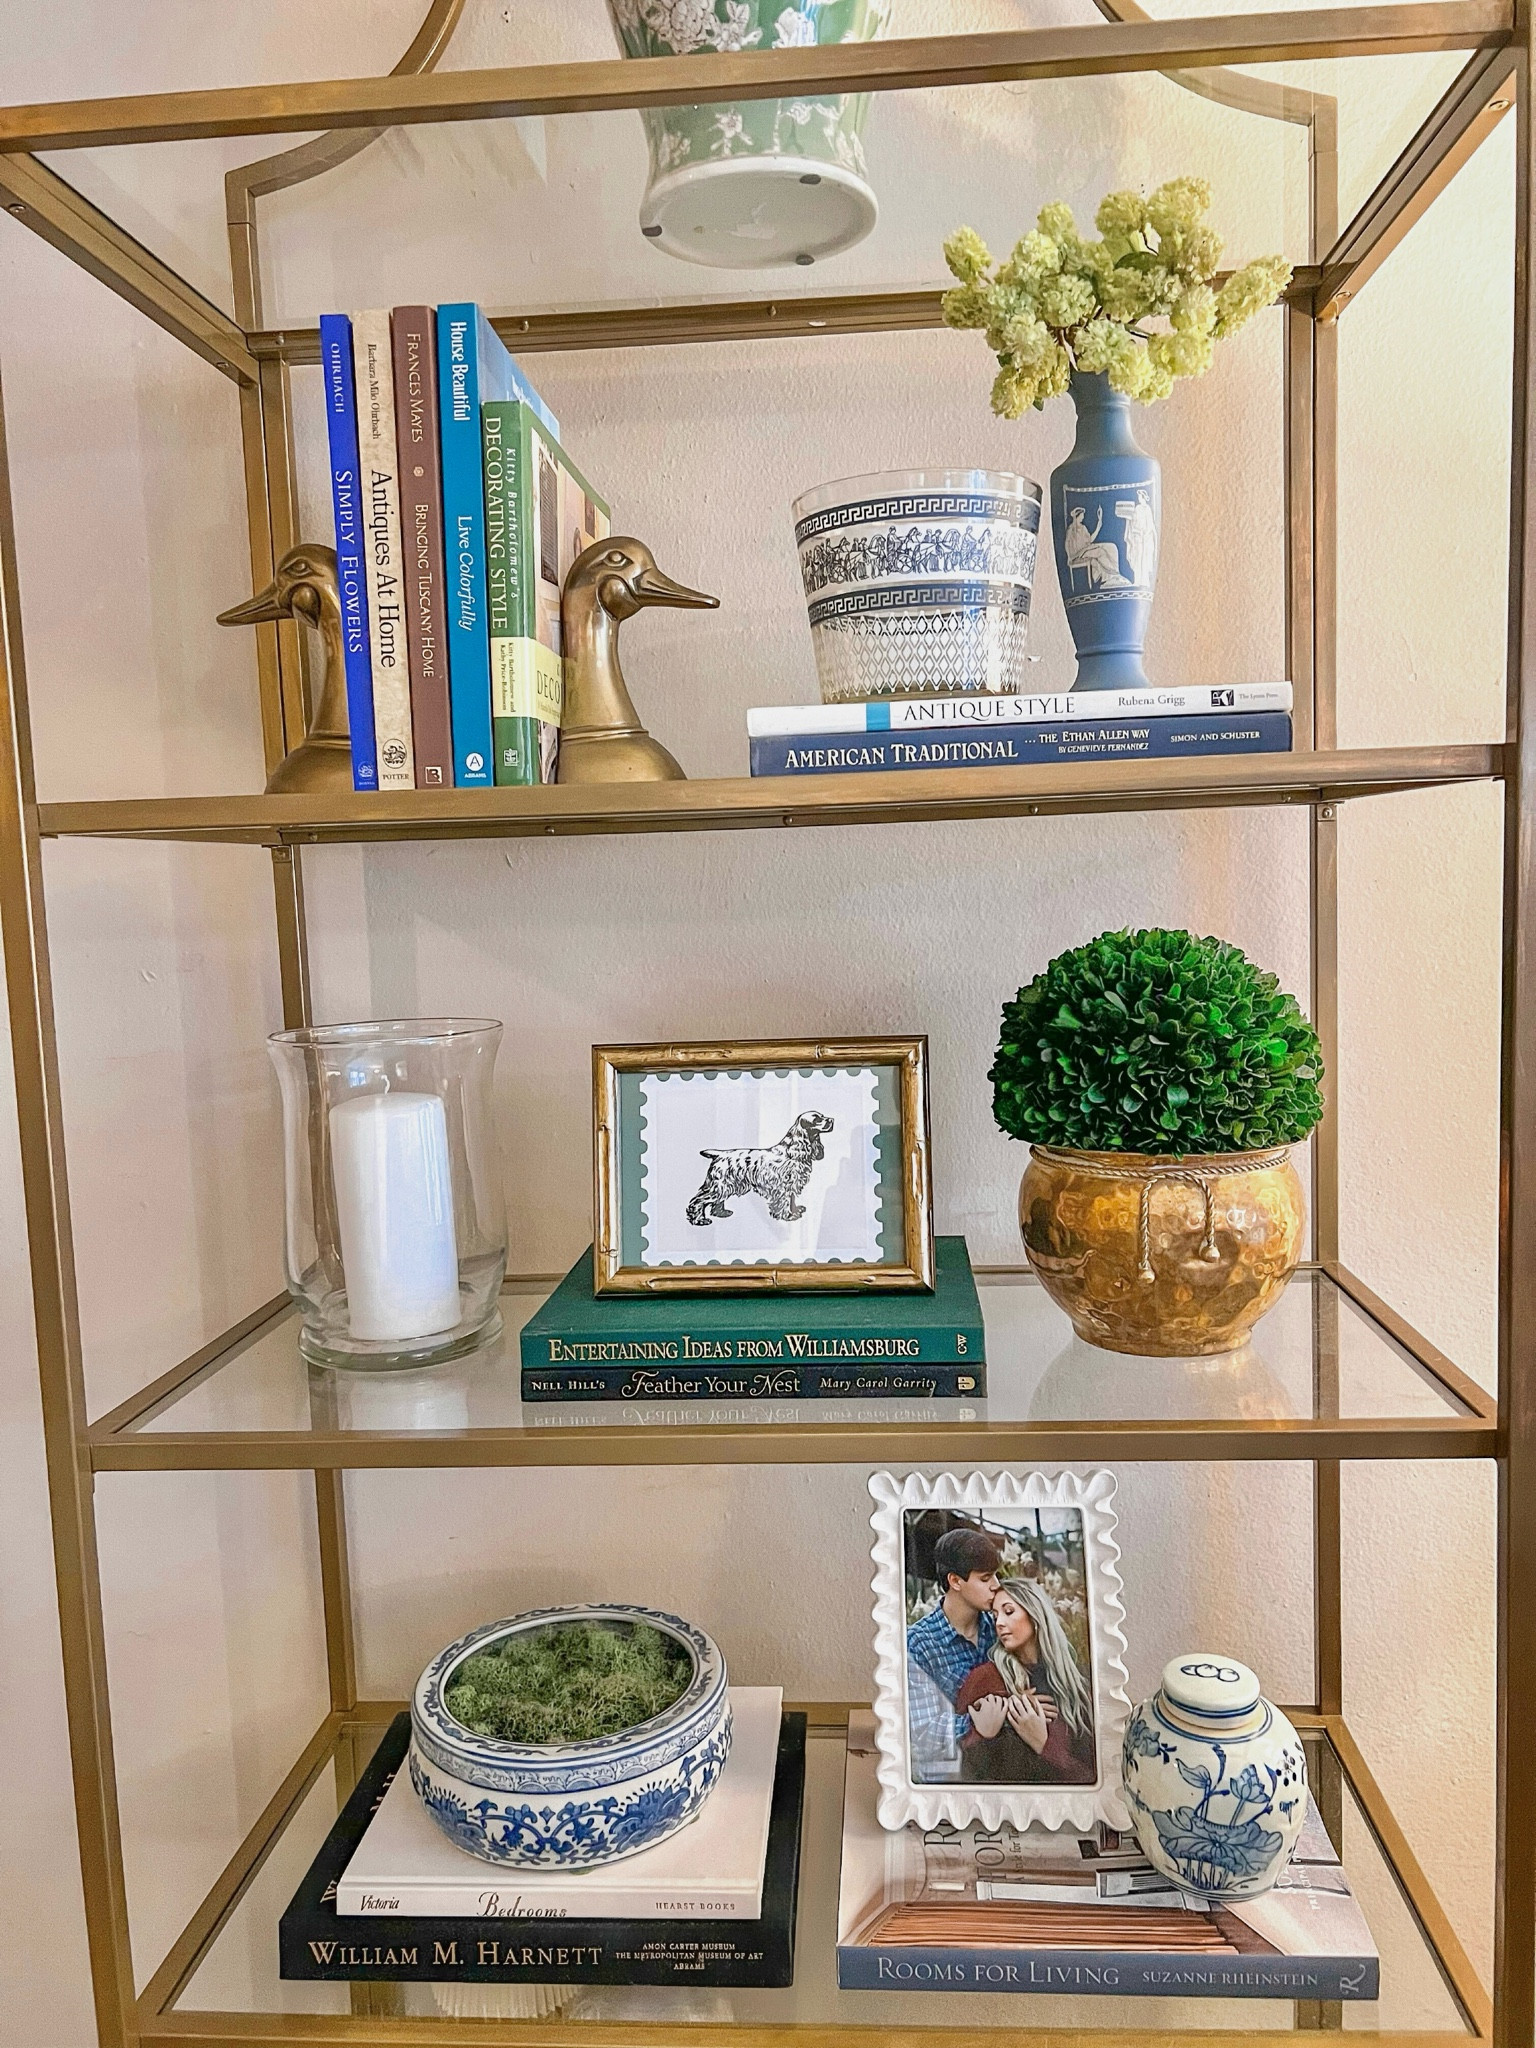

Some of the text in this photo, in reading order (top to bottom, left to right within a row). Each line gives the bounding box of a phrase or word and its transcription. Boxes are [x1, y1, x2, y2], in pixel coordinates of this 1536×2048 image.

[330, 343, 344, 413] OHRBACH
[368, 344, 378, 378] Barbara
[450, 322, 471, 421] House Beautiful
[407, 333, 424, 443] FRANCES MAYES
[371, 403, 381, 440] Ohrbach
[485, 416, 508, 630] DECORATING STYLE
[505, 448, 520, 599] Kitty Bartholomew's
[335, 470, 362, 653] SIMPLY FLOWERS
[369, 470, 400, 668] Antiques At Home
[458, 516, 476, 631] Live Colorfully
[415, 504, 435, 678] BRINGING TUSCANY HOME
[904, 694, 1186, 722] ANTIQUE STYLE Rubena Grigg
[785, 746, 885, 768] AMERICAN
[890, 740, 1019, 762] TRADITIONAL
[1038, 733, 1058, 744] THE
[1062, 730, 1095, 742] ETHAN
[1098, 729, 1130, 740] ALLEN
[1130, 728, 1150, 739] WAY
[1058, 742, 1150, 754] BY GENEVIEVE FERNANDEZ
[1170, 731, 1260, 743] SIMON AND SCHUSTER
[548, 1334, 920, 1362] ENTERTAINING IDEAS FROM WILLIAMSBURG
[531, 1370, 937, 1398] NELL HILL'S Feather Your Nest Mary Carol Garrity
[360, 1891, 736, 1918] Victoria Bedrooms HEARST BOOKS
[308, 1941, 602, 1965] WILLIAM M. HARNETT
[616, 1952, 764, 1961] THE METROPOLITAN MUSEUM OF ART
[674, 1962, 705, 1970] ABRAMS
[878, 1956, 1318, 1986] ROOMS FOR LIVING SUZANNE RHEINSTEIN
